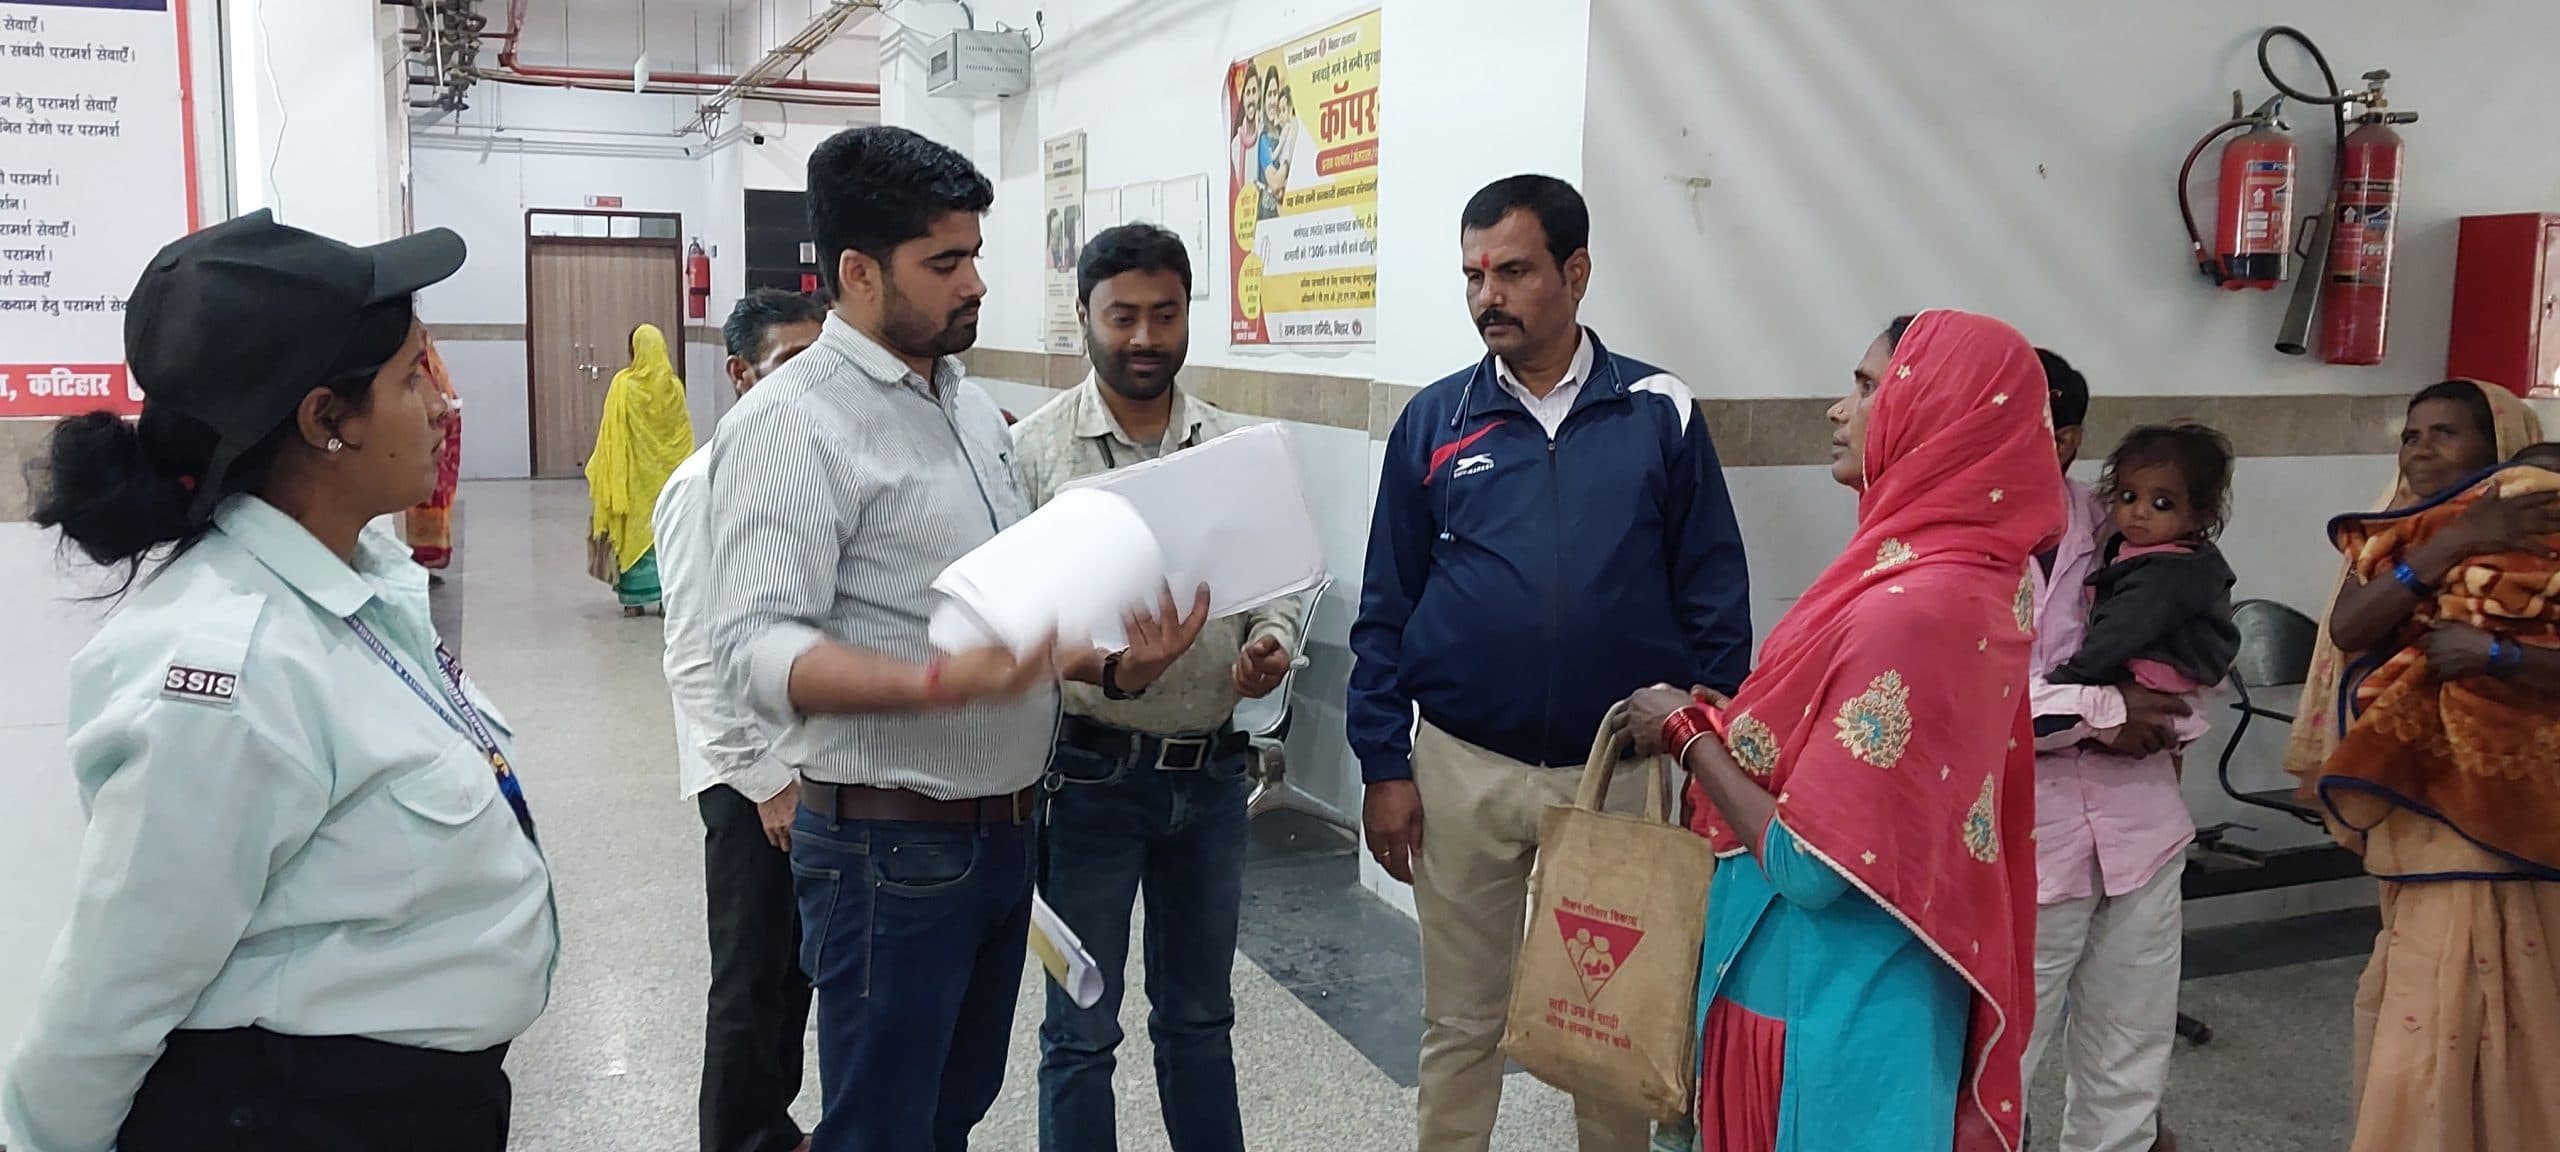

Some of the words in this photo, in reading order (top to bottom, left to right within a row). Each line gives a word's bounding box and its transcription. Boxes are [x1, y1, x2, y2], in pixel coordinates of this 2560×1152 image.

[50, 43, 91, 60] परामर्श
[16, 91, 34, 114] हेतु
[38, 94, 80, 111] परामर्श
[1319, 79, 1378, 143] कॉपर
[57, 121, 73, 136] पर
[78, 120, 120, 137] परामर्श
[42, 295, 60, 316] हेतु
[64, 296, 105, 312] परामर्श
[110, 298, 127, 312] सेव
[26, 368, 111, 396] कटिहार
[165, 667, 236, 697] SSIS
